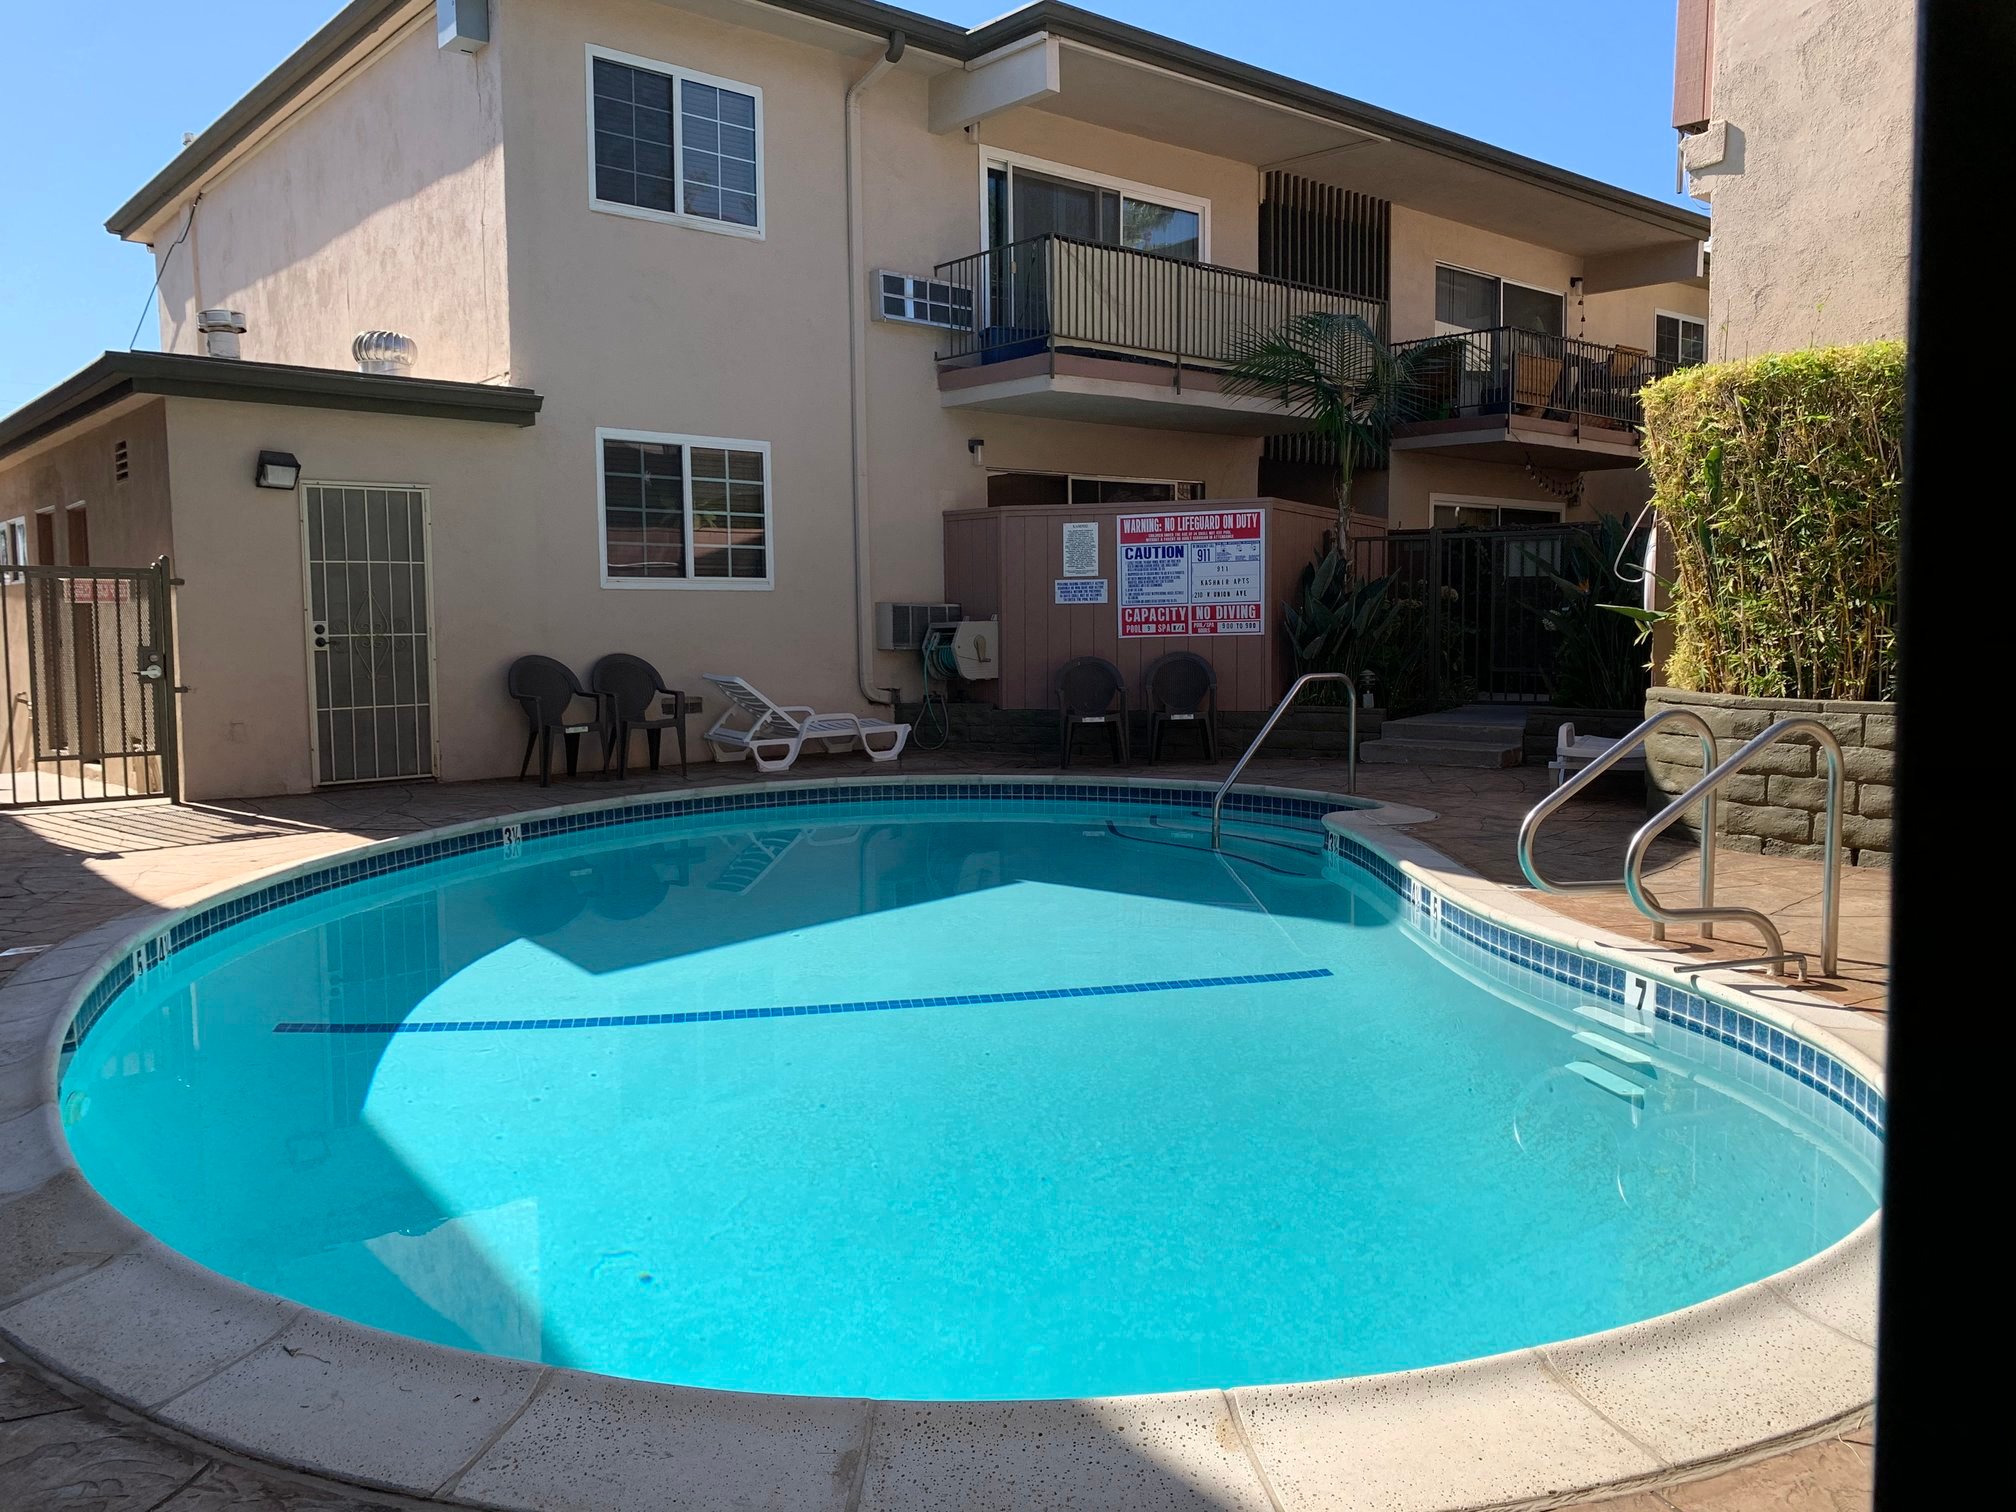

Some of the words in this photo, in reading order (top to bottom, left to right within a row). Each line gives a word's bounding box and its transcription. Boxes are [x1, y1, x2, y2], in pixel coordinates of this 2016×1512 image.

[1123, 517, 1162, 533] WARNING:
[1165, 517, 1175, 532] NO
[1177, 515, 1220, 531] LIFEGUARD
[1223, 514, 1233, 529] ON
[1236, 513, 1258, 528] DUTY
[1125, 545, 1184, 560] CAUTION
[1197, 549, 1211, 562] 911
[1233, 577, 1250, 585] APTS
[1236, 589, 1248, 597] AVE
[1125, 607, 1187, 622] CAPACITY
[1196, 606, 1211, 620] NO
[1216, 605, 1256, 620] DIVING
[1126, 624, 1142, 633] POOL
[1157, 623, 1171, 633] SPA
[1635, 977, 1647, 1011] 7
